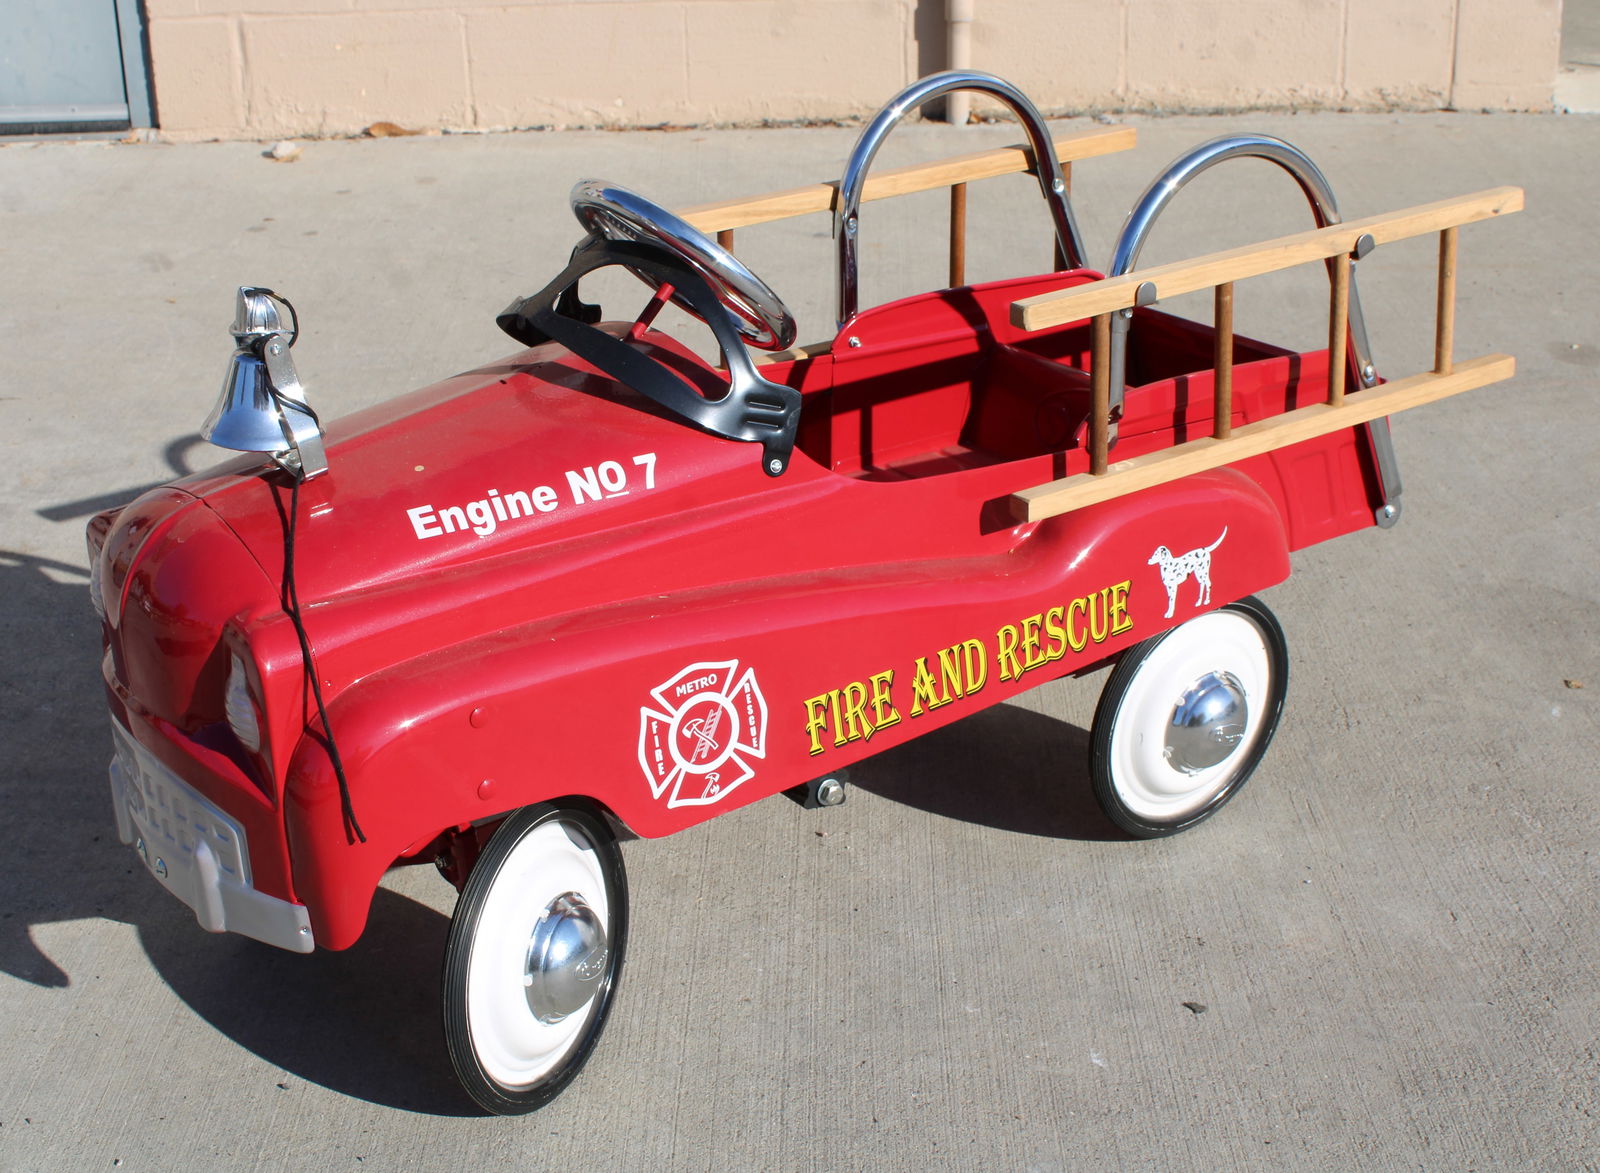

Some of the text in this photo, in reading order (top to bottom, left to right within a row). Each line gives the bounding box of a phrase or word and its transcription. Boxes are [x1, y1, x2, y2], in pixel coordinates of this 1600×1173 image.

[406, 452, 657, 540] Engine NO 7
[675, 673, 718, 698] METRO
[803, 579, 1134, 756] FIRE AND RESCUE
[651, 720, 665, 776] FIRE
[743, 682, 759, 748] RESCUE
